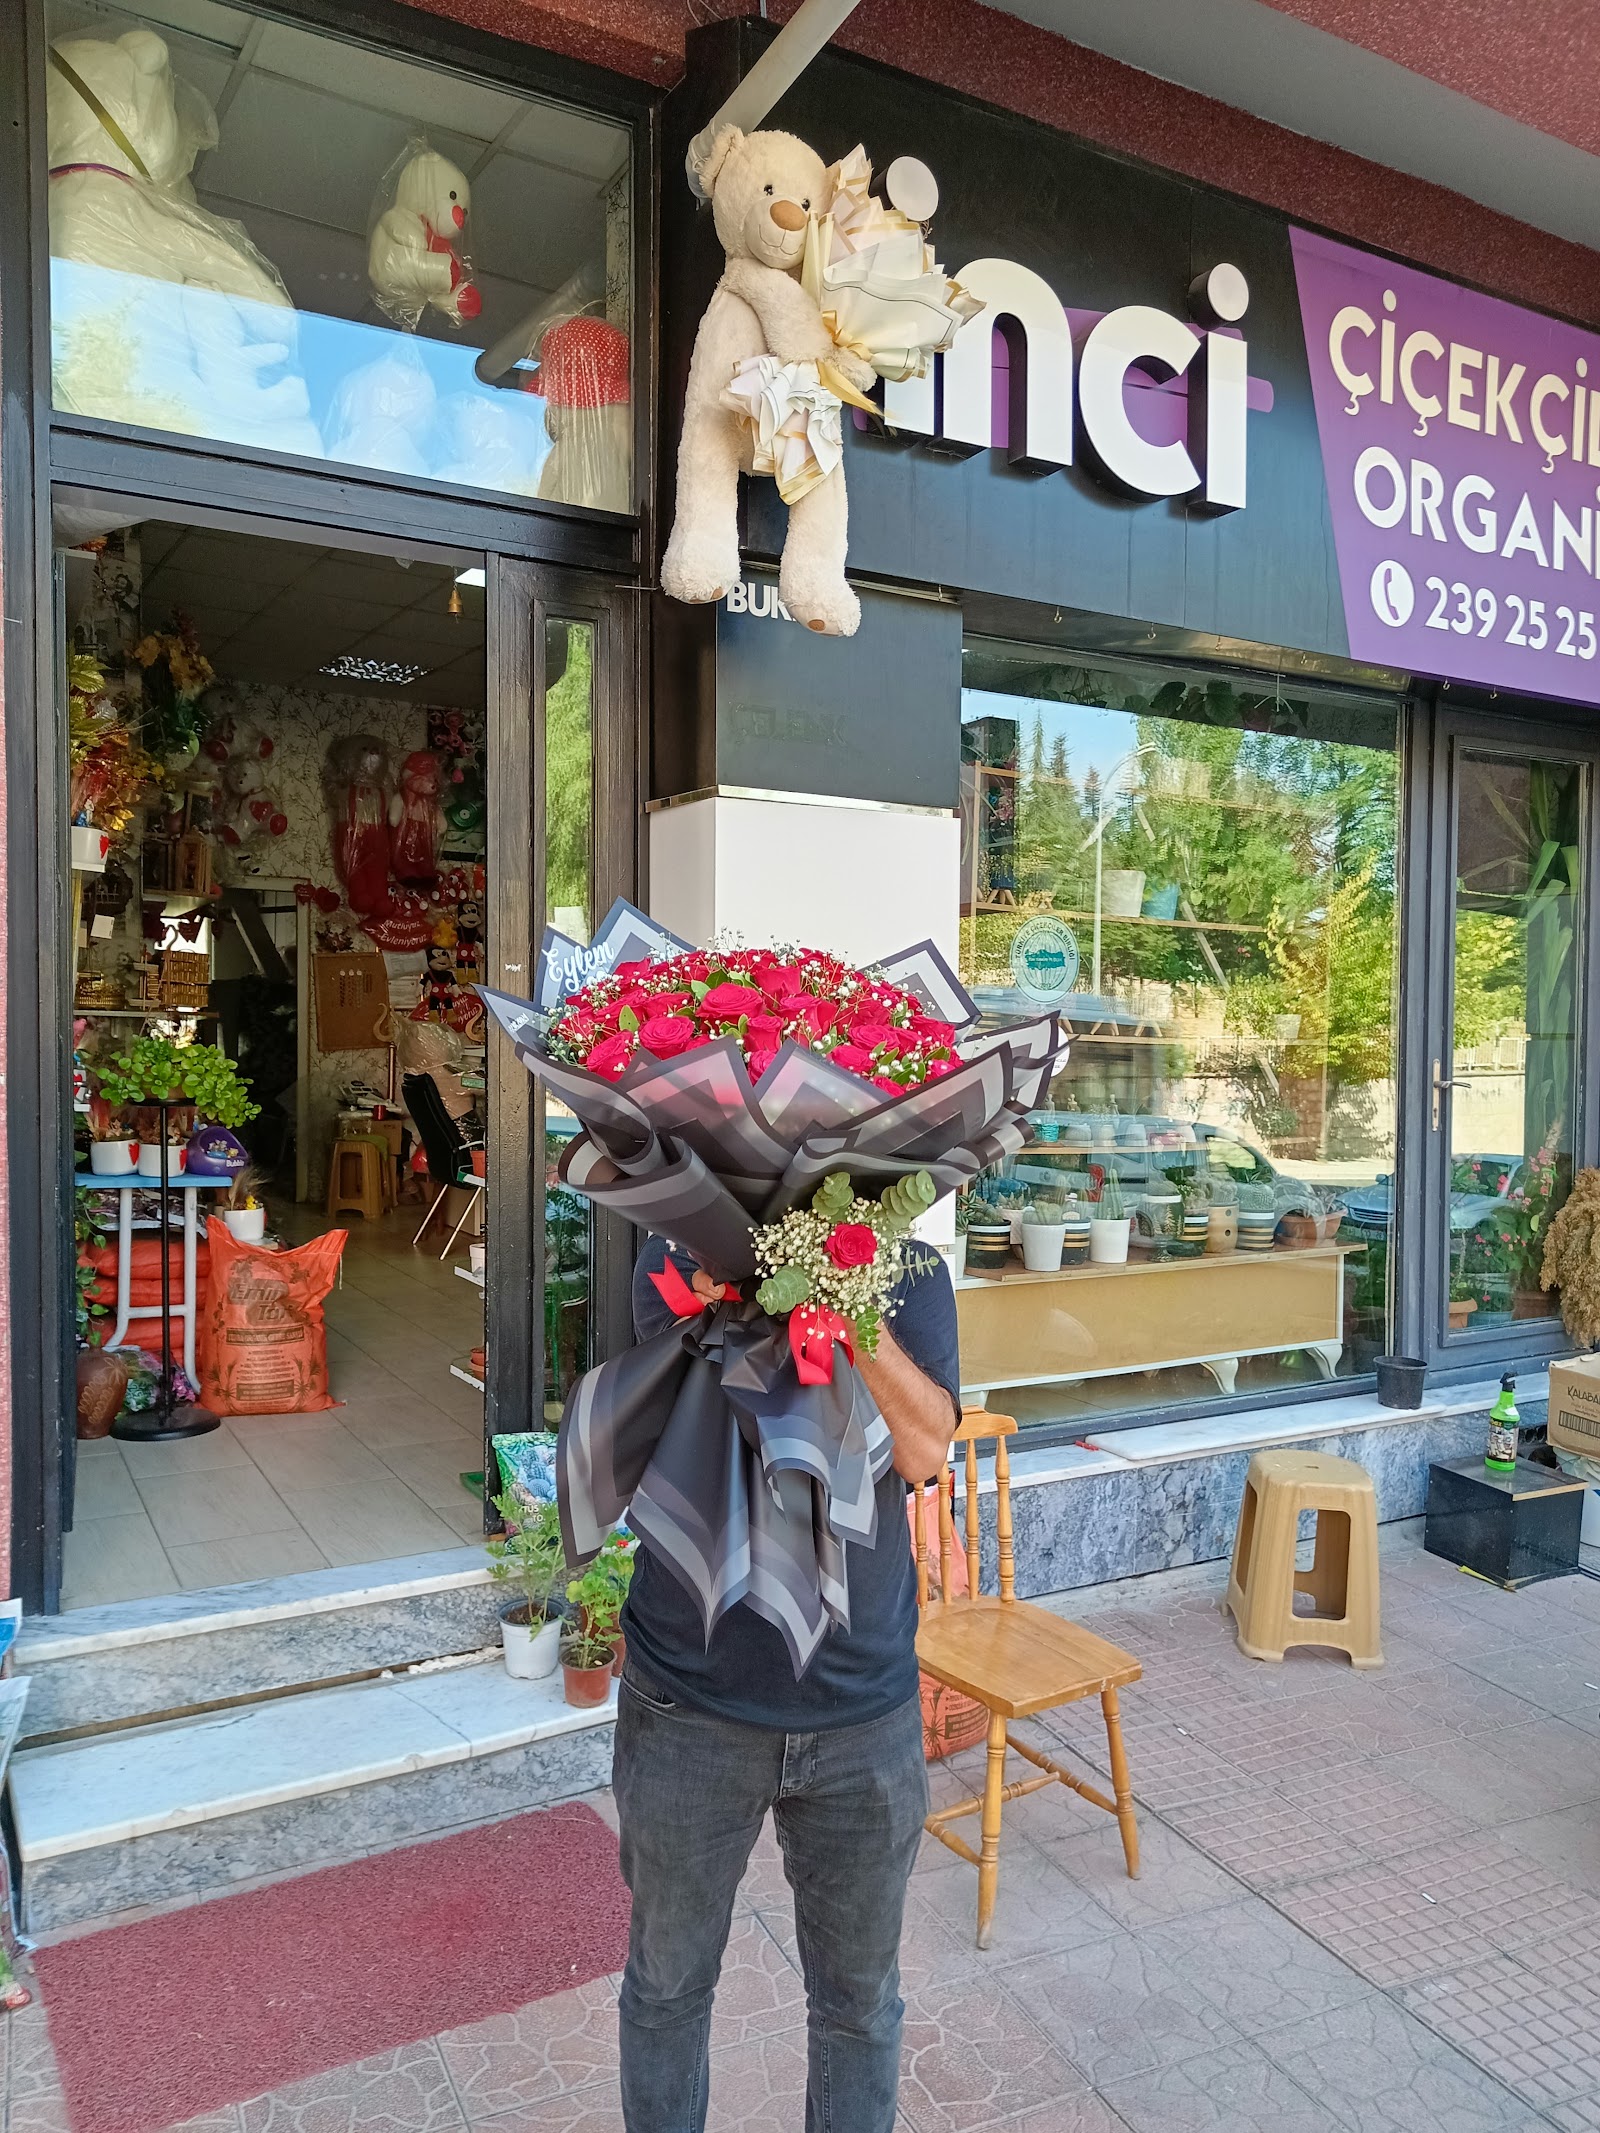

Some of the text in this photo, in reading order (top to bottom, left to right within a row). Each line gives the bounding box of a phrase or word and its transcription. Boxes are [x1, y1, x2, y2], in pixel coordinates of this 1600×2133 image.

[727, 581, 797, 622] BUK
[1424, 576, 1597, 660] 239 25 25
[541, 941, 615, 992] Eylem
[1567, 1386, 1600, 1406] KALABA
